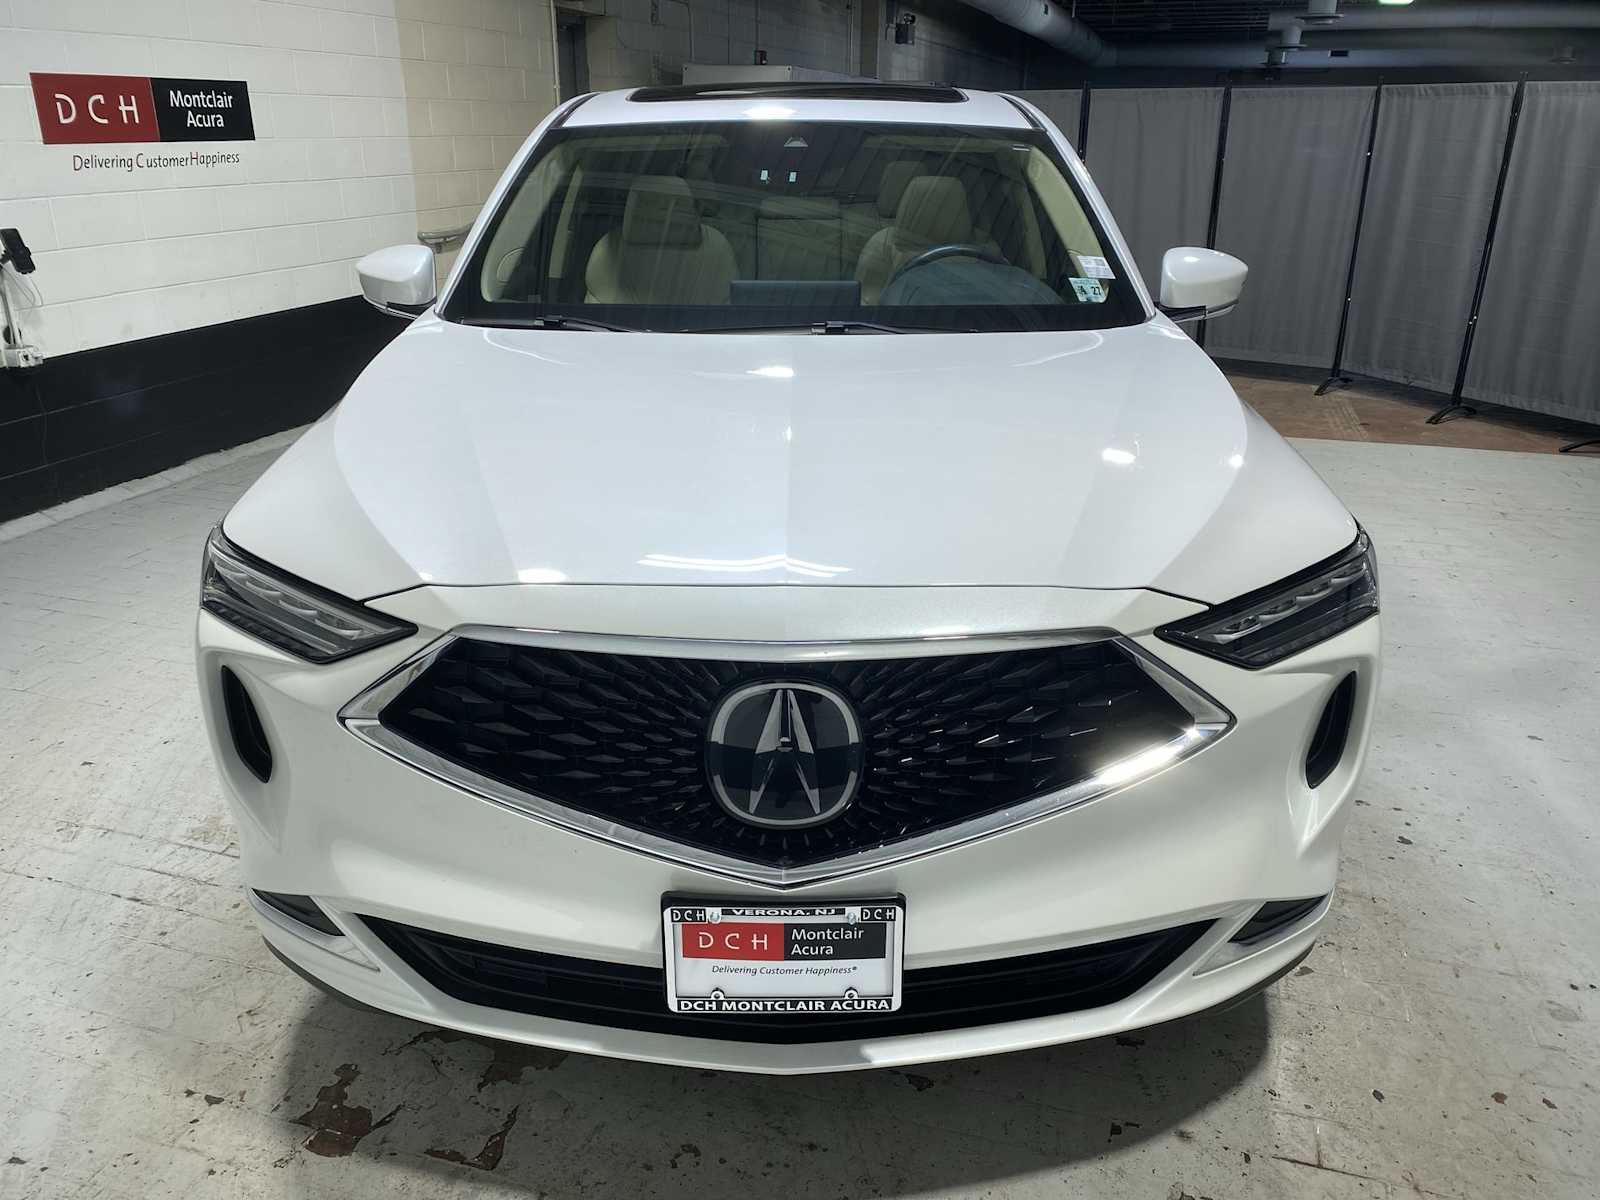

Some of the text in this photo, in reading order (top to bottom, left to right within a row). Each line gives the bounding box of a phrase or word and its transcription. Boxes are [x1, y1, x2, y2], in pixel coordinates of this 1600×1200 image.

[169, 90, 233, 109] Montclair
[186, 110, 225, 128] Acura
[72, 154, 133, 172] Delivering
[672, 909, 705, 921] DCH
[732, 908, 836, 917] VERONA, NJ
[862, 908, 895, 920] DCH
[698, 931, 768, 951] DCH
[791, 928, 864, 941] Montclair
[791, 942, 834, 956] Acura
[711, 964, 757, 976] Delivering
[759, 966, 803, 975] Customer
[680, 1000, 890, 1011] DCH MONTCLAIR ACURA
